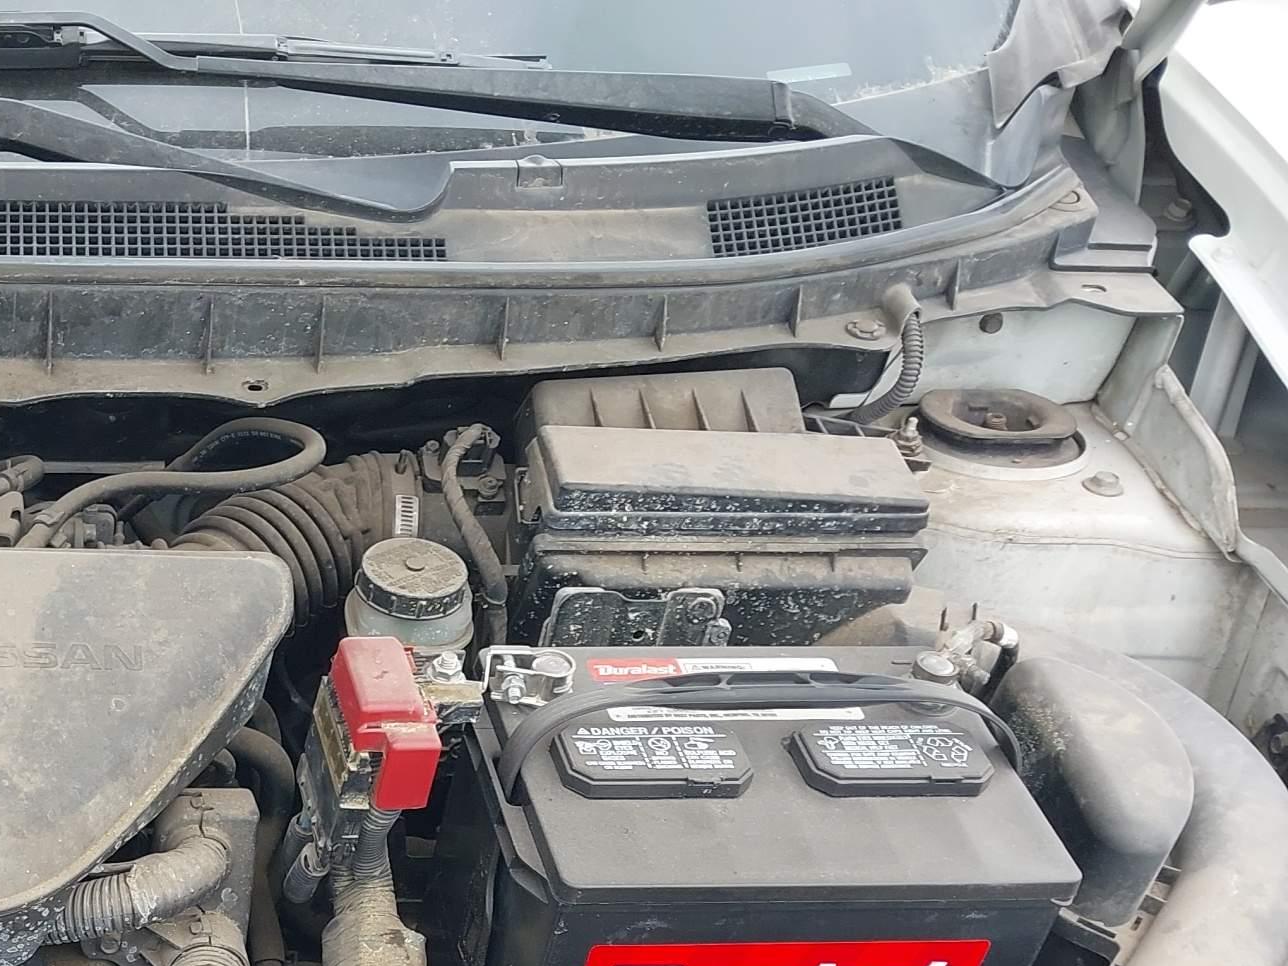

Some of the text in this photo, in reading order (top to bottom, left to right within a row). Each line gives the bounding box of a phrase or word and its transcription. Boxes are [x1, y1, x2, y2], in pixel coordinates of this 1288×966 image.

[593, 664, 677, 676] Duralast
[590, 727, 648, 736] DANGER
[662, 726, 714, 735] POISON
